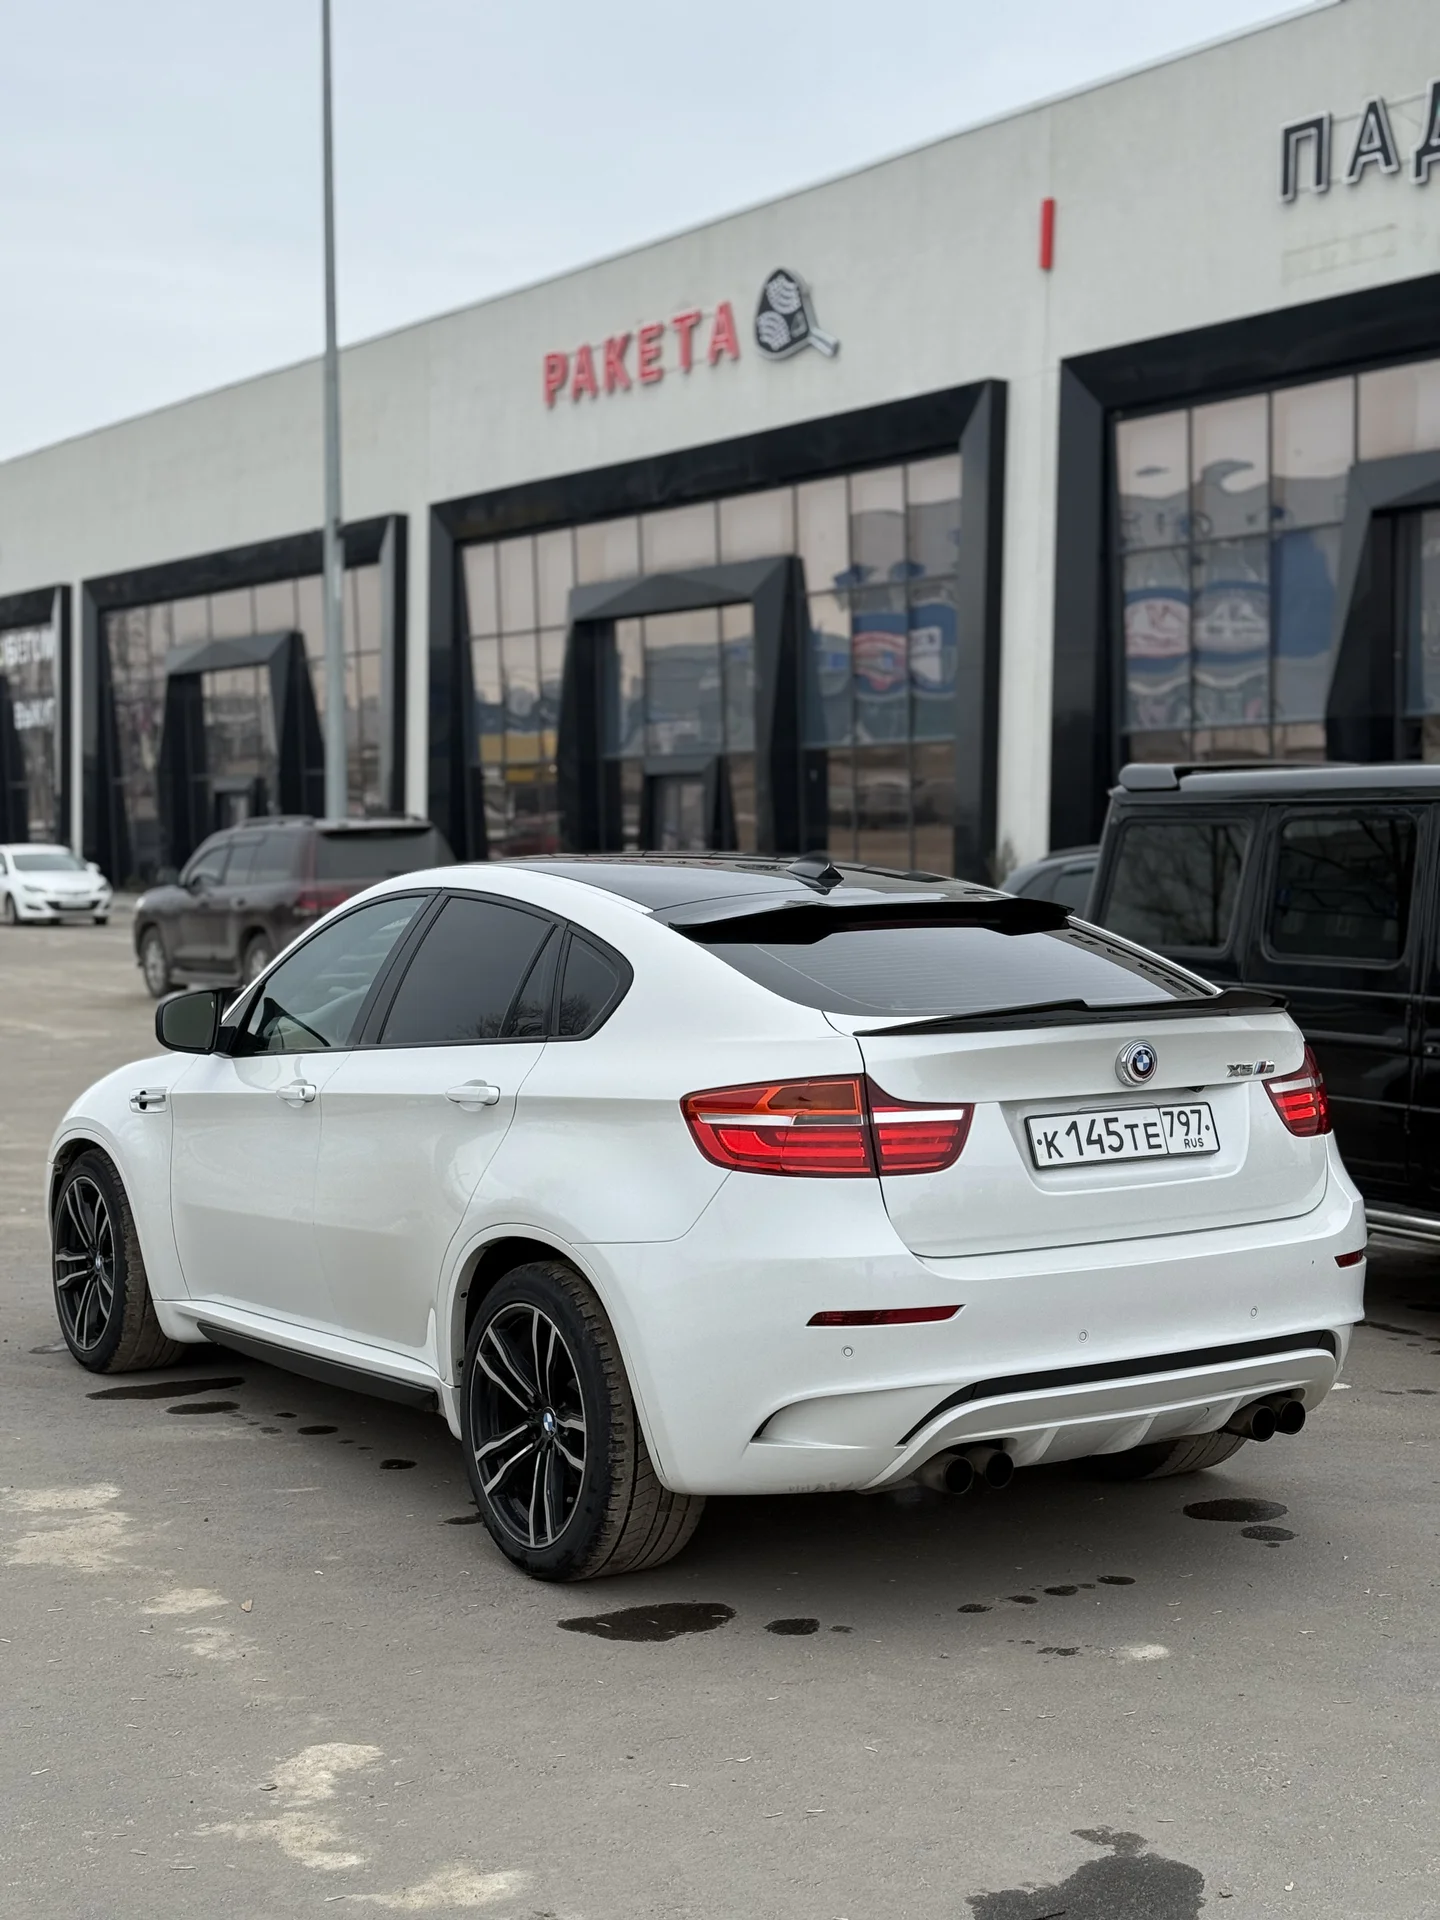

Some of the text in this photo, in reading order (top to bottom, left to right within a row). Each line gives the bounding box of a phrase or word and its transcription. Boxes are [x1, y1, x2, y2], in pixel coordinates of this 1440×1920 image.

[543, 301, 741, 406] РАКЕТА
[1043, 1109, 1202, 1159] К145ТЕ 797
[1184, 1137, 1204, 1149] RUS
